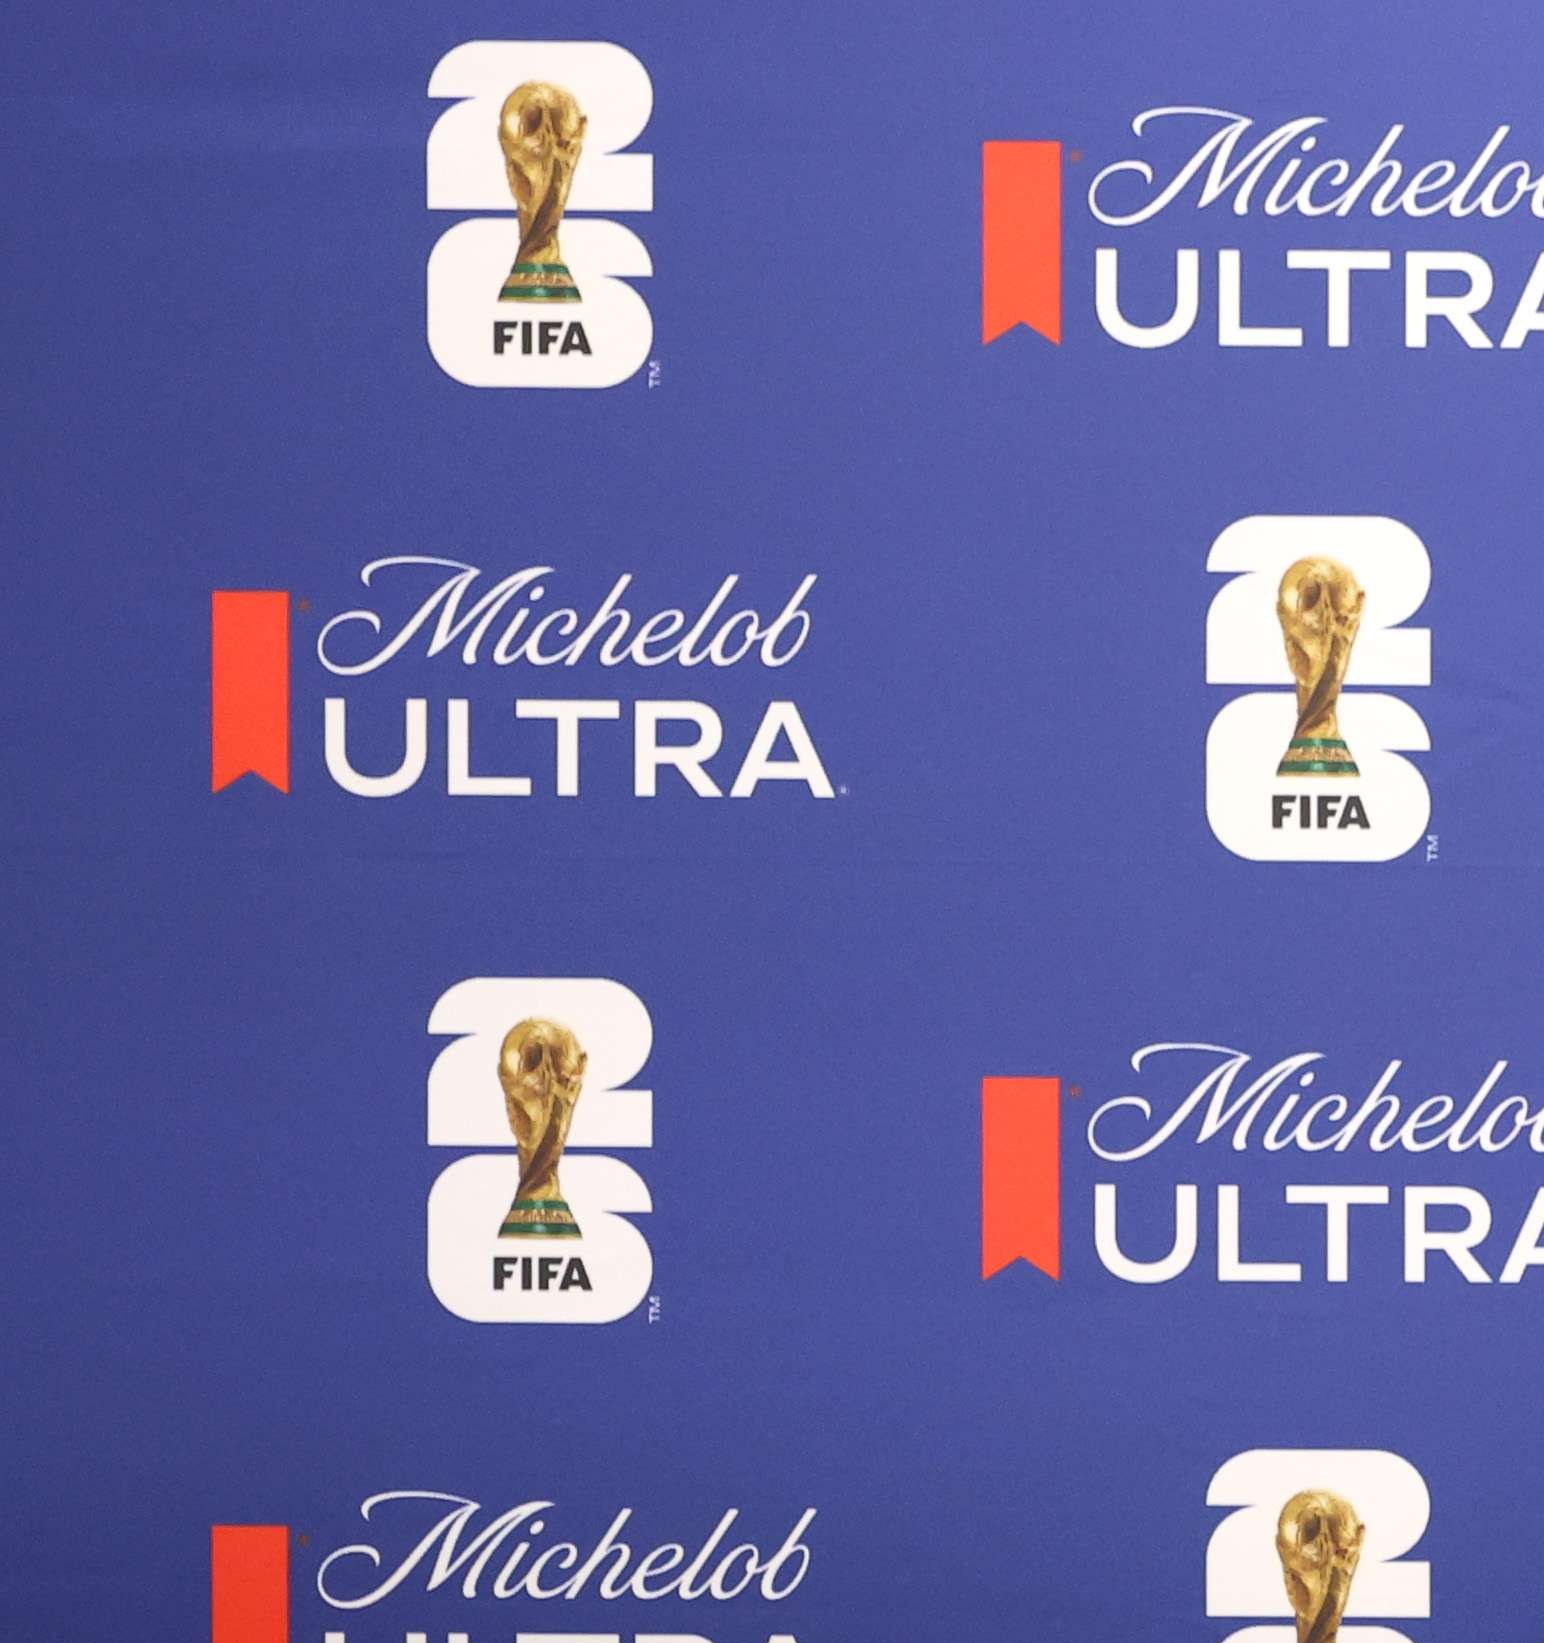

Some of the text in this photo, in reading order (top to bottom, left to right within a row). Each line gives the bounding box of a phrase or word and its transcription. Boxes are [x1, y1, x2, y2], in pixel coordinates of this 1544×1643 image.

[493, 320, 593, 356] FIFA
[317, 555, 818, 676] Michelob
[324, 697, 836, 799] ULTRA
[1271, 794, 1371, 830] FIFA
[492, 1256, 593, 1292] FIFA
[317, 1490, 817, 1609] Michelob
